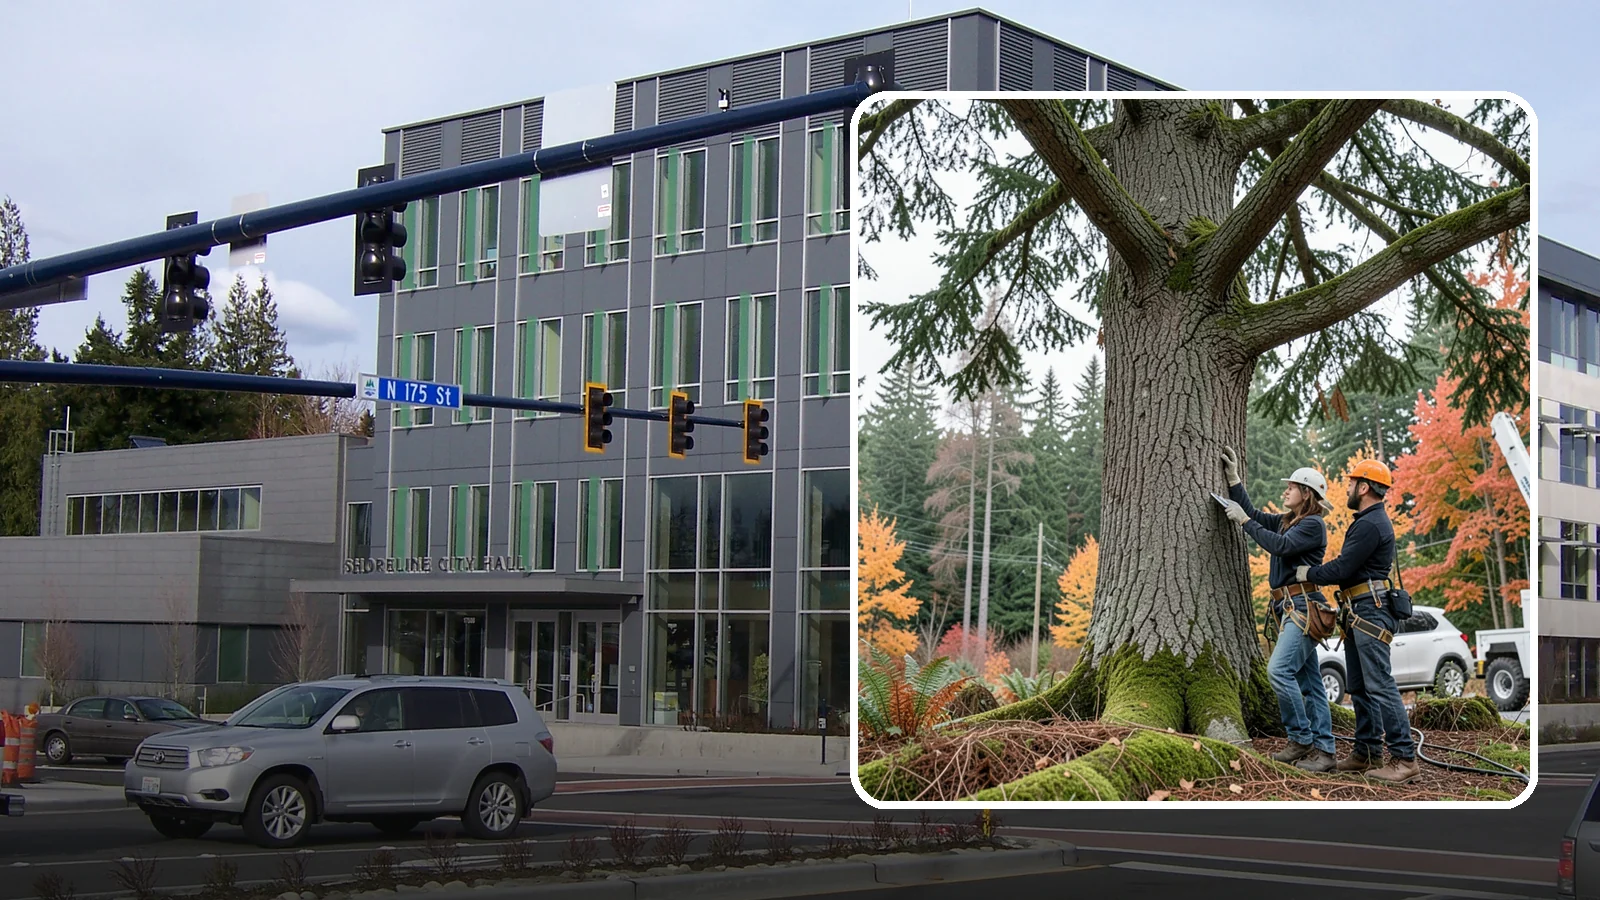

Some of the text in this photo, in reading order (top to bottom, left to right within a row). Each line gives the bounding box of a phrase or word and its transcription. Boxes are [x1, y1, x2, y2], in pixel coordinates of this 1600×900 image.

[387, 381, 451, 406] N 175 St
[344, 556, 525, 574] SHORELINE CITY HALL
